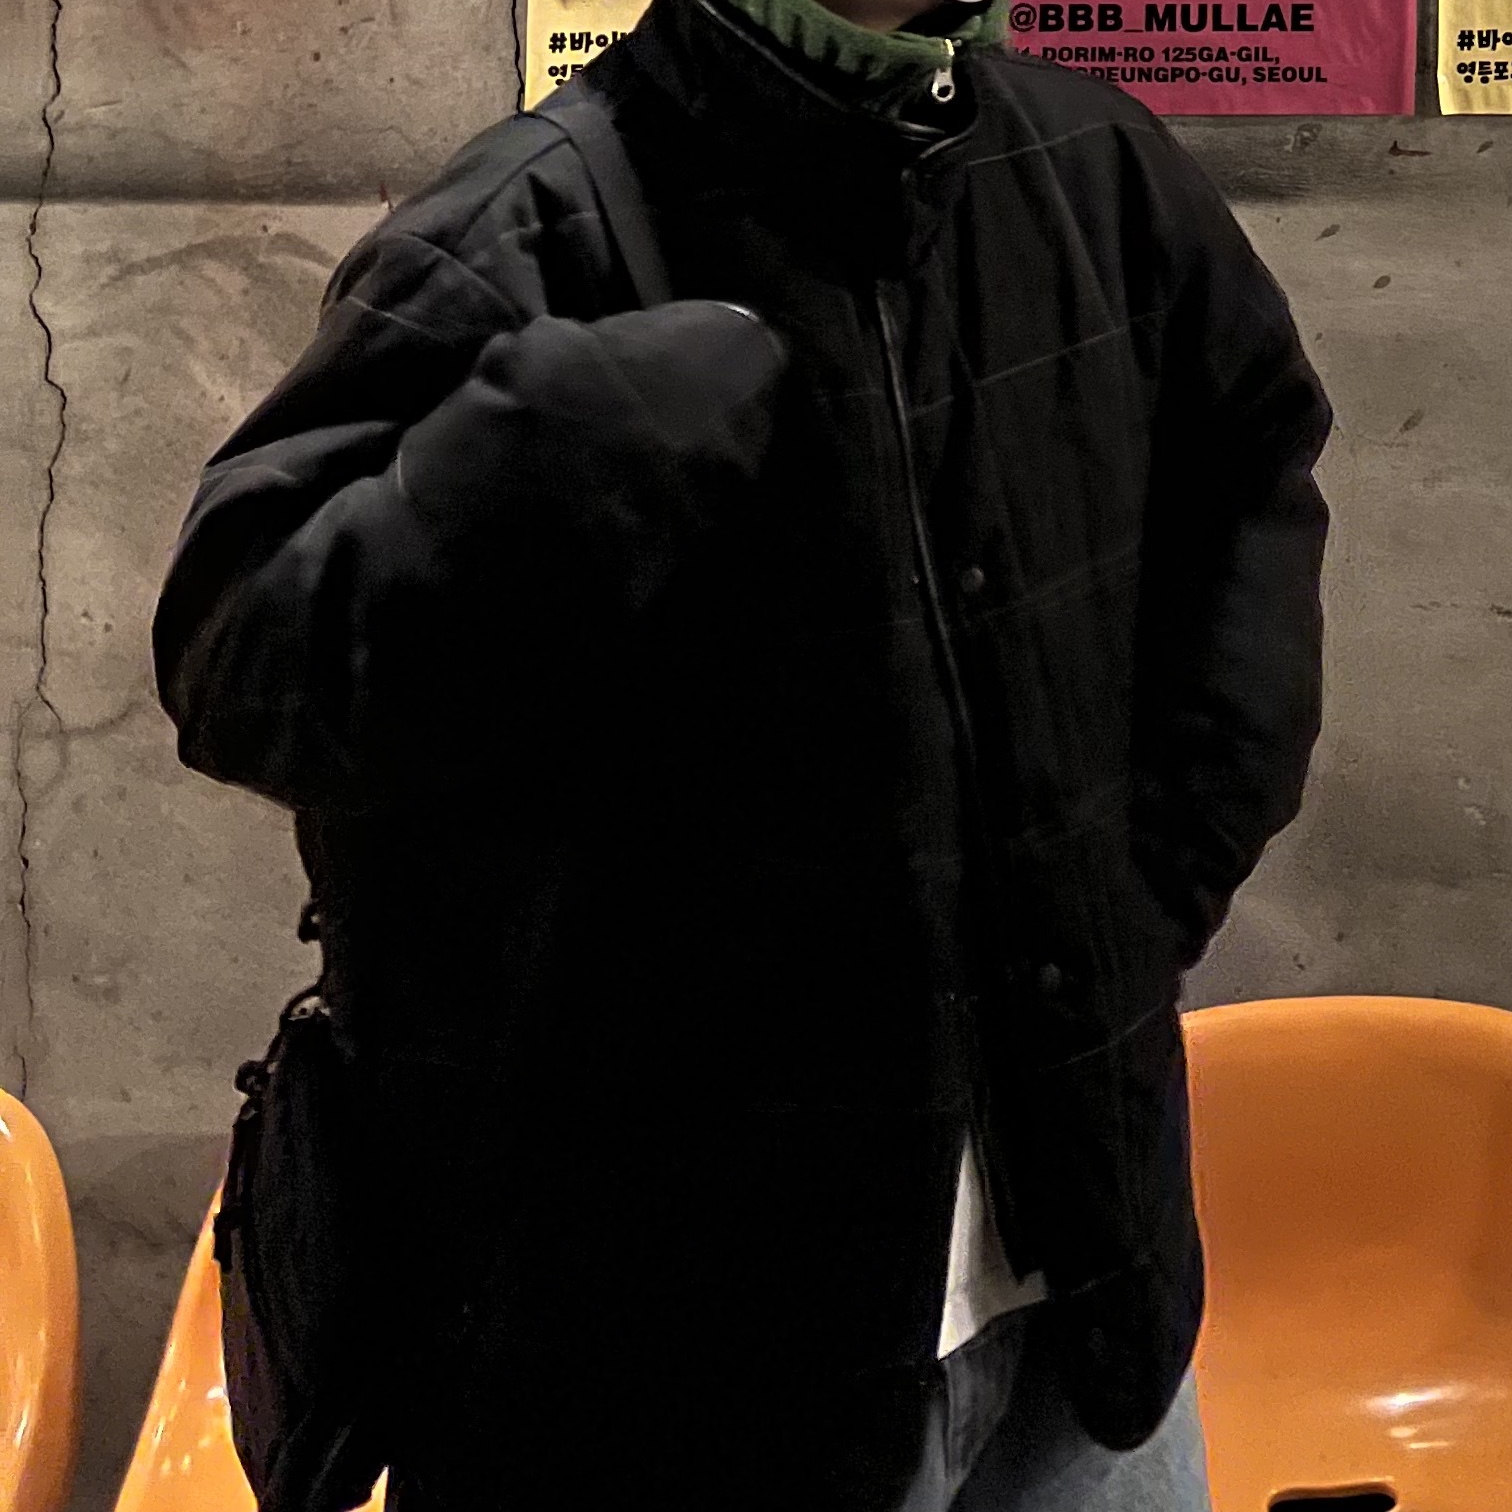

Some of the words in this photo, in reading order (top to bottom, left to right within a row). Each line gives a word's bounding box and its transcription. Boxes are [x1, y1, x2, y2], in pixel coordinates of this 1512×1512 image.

[1009, 2, 1314, 33] @BBB_MULLAE
[1042, 46, 1156, 64] DORIM-RO
[1161, 45, 1280, 66] 125GA-GIL,
[1076, 66, 1247, 86] DEUNGPO-GU,
[1253, 66, 1328, 83] SEOUL
